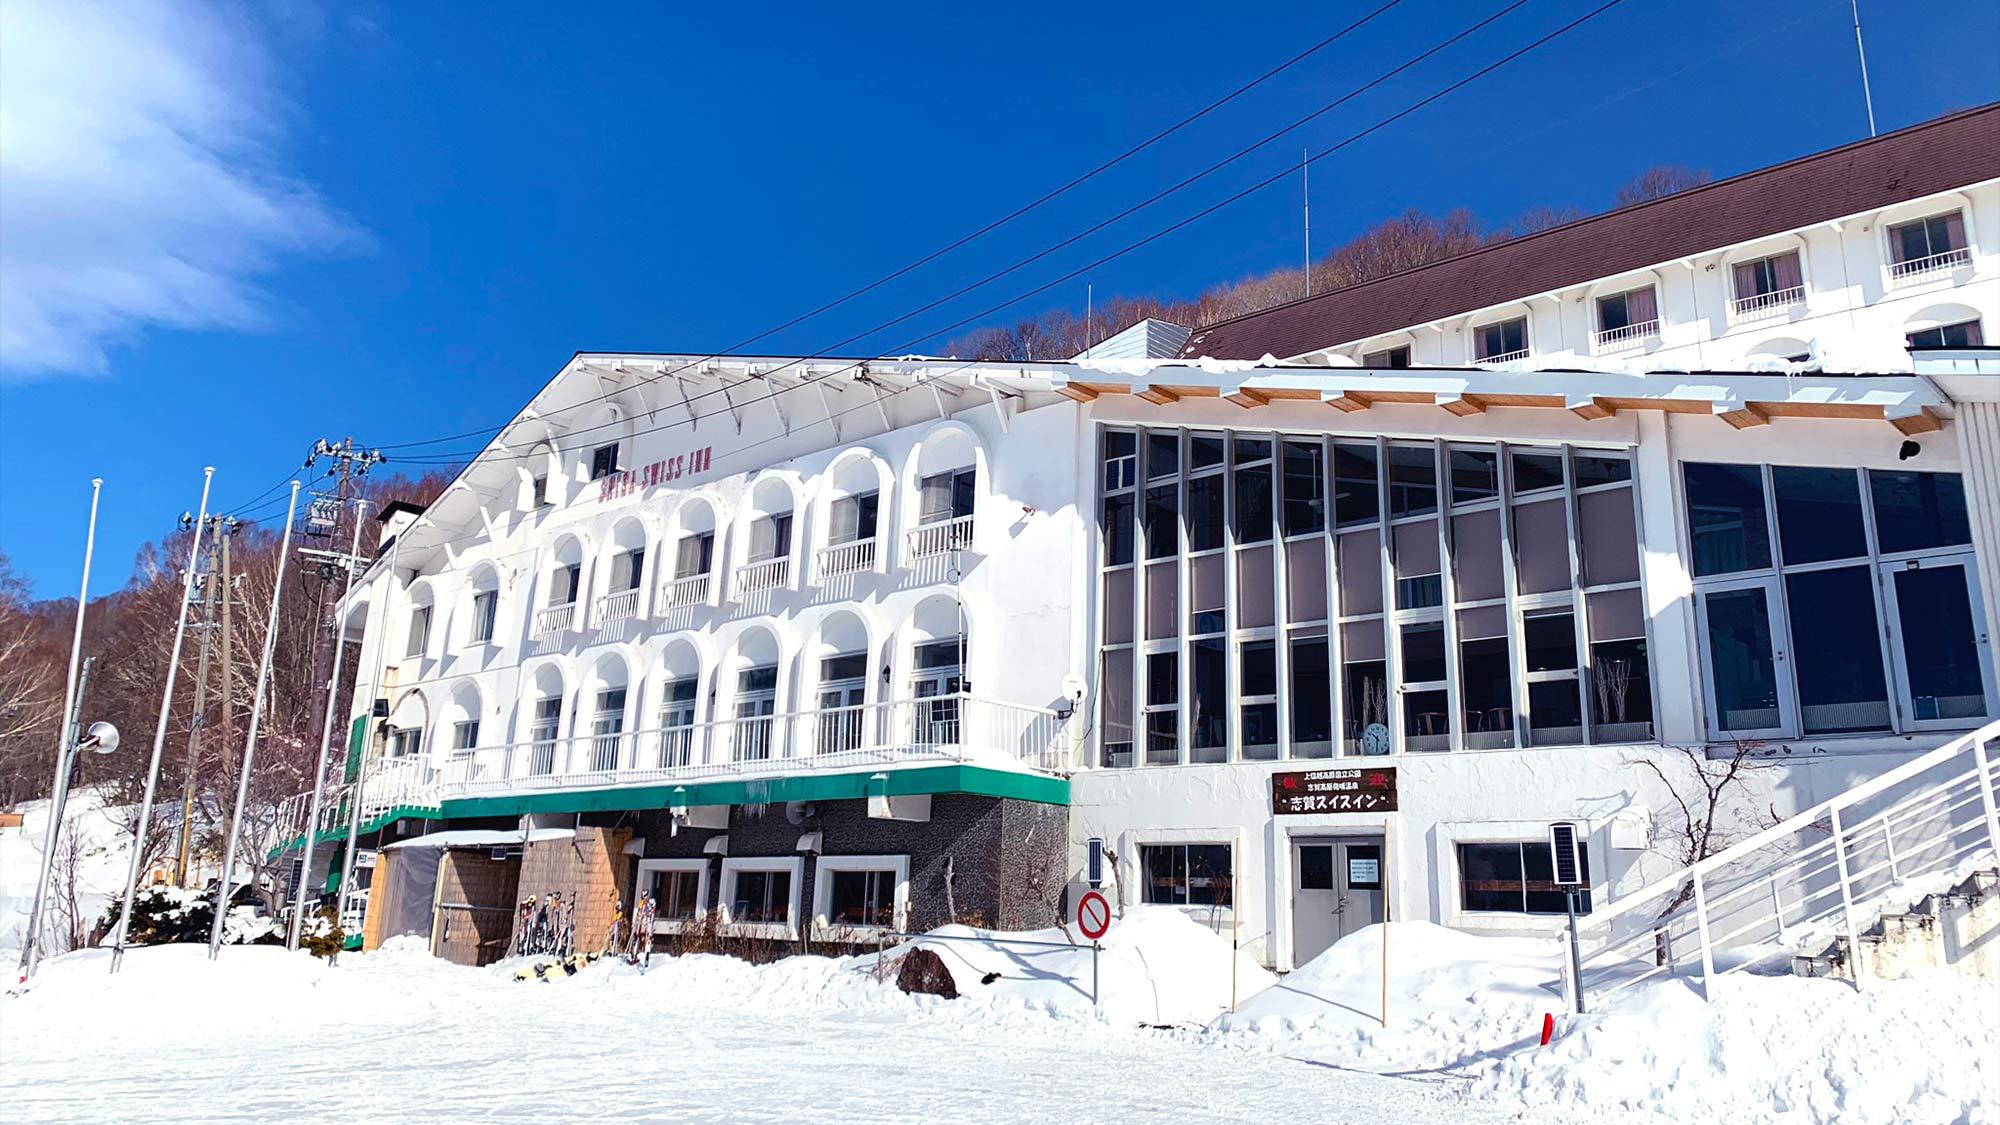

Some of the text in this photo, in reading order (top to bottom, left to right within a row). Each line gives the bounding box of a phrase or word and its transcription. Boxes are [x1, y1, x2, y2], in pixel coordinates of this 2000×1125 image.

[640, 455, 685, 491] SWISS
[688, 446, 712, 475] INN
[1290, 794, 1377, 811] 志賀スイスイン
